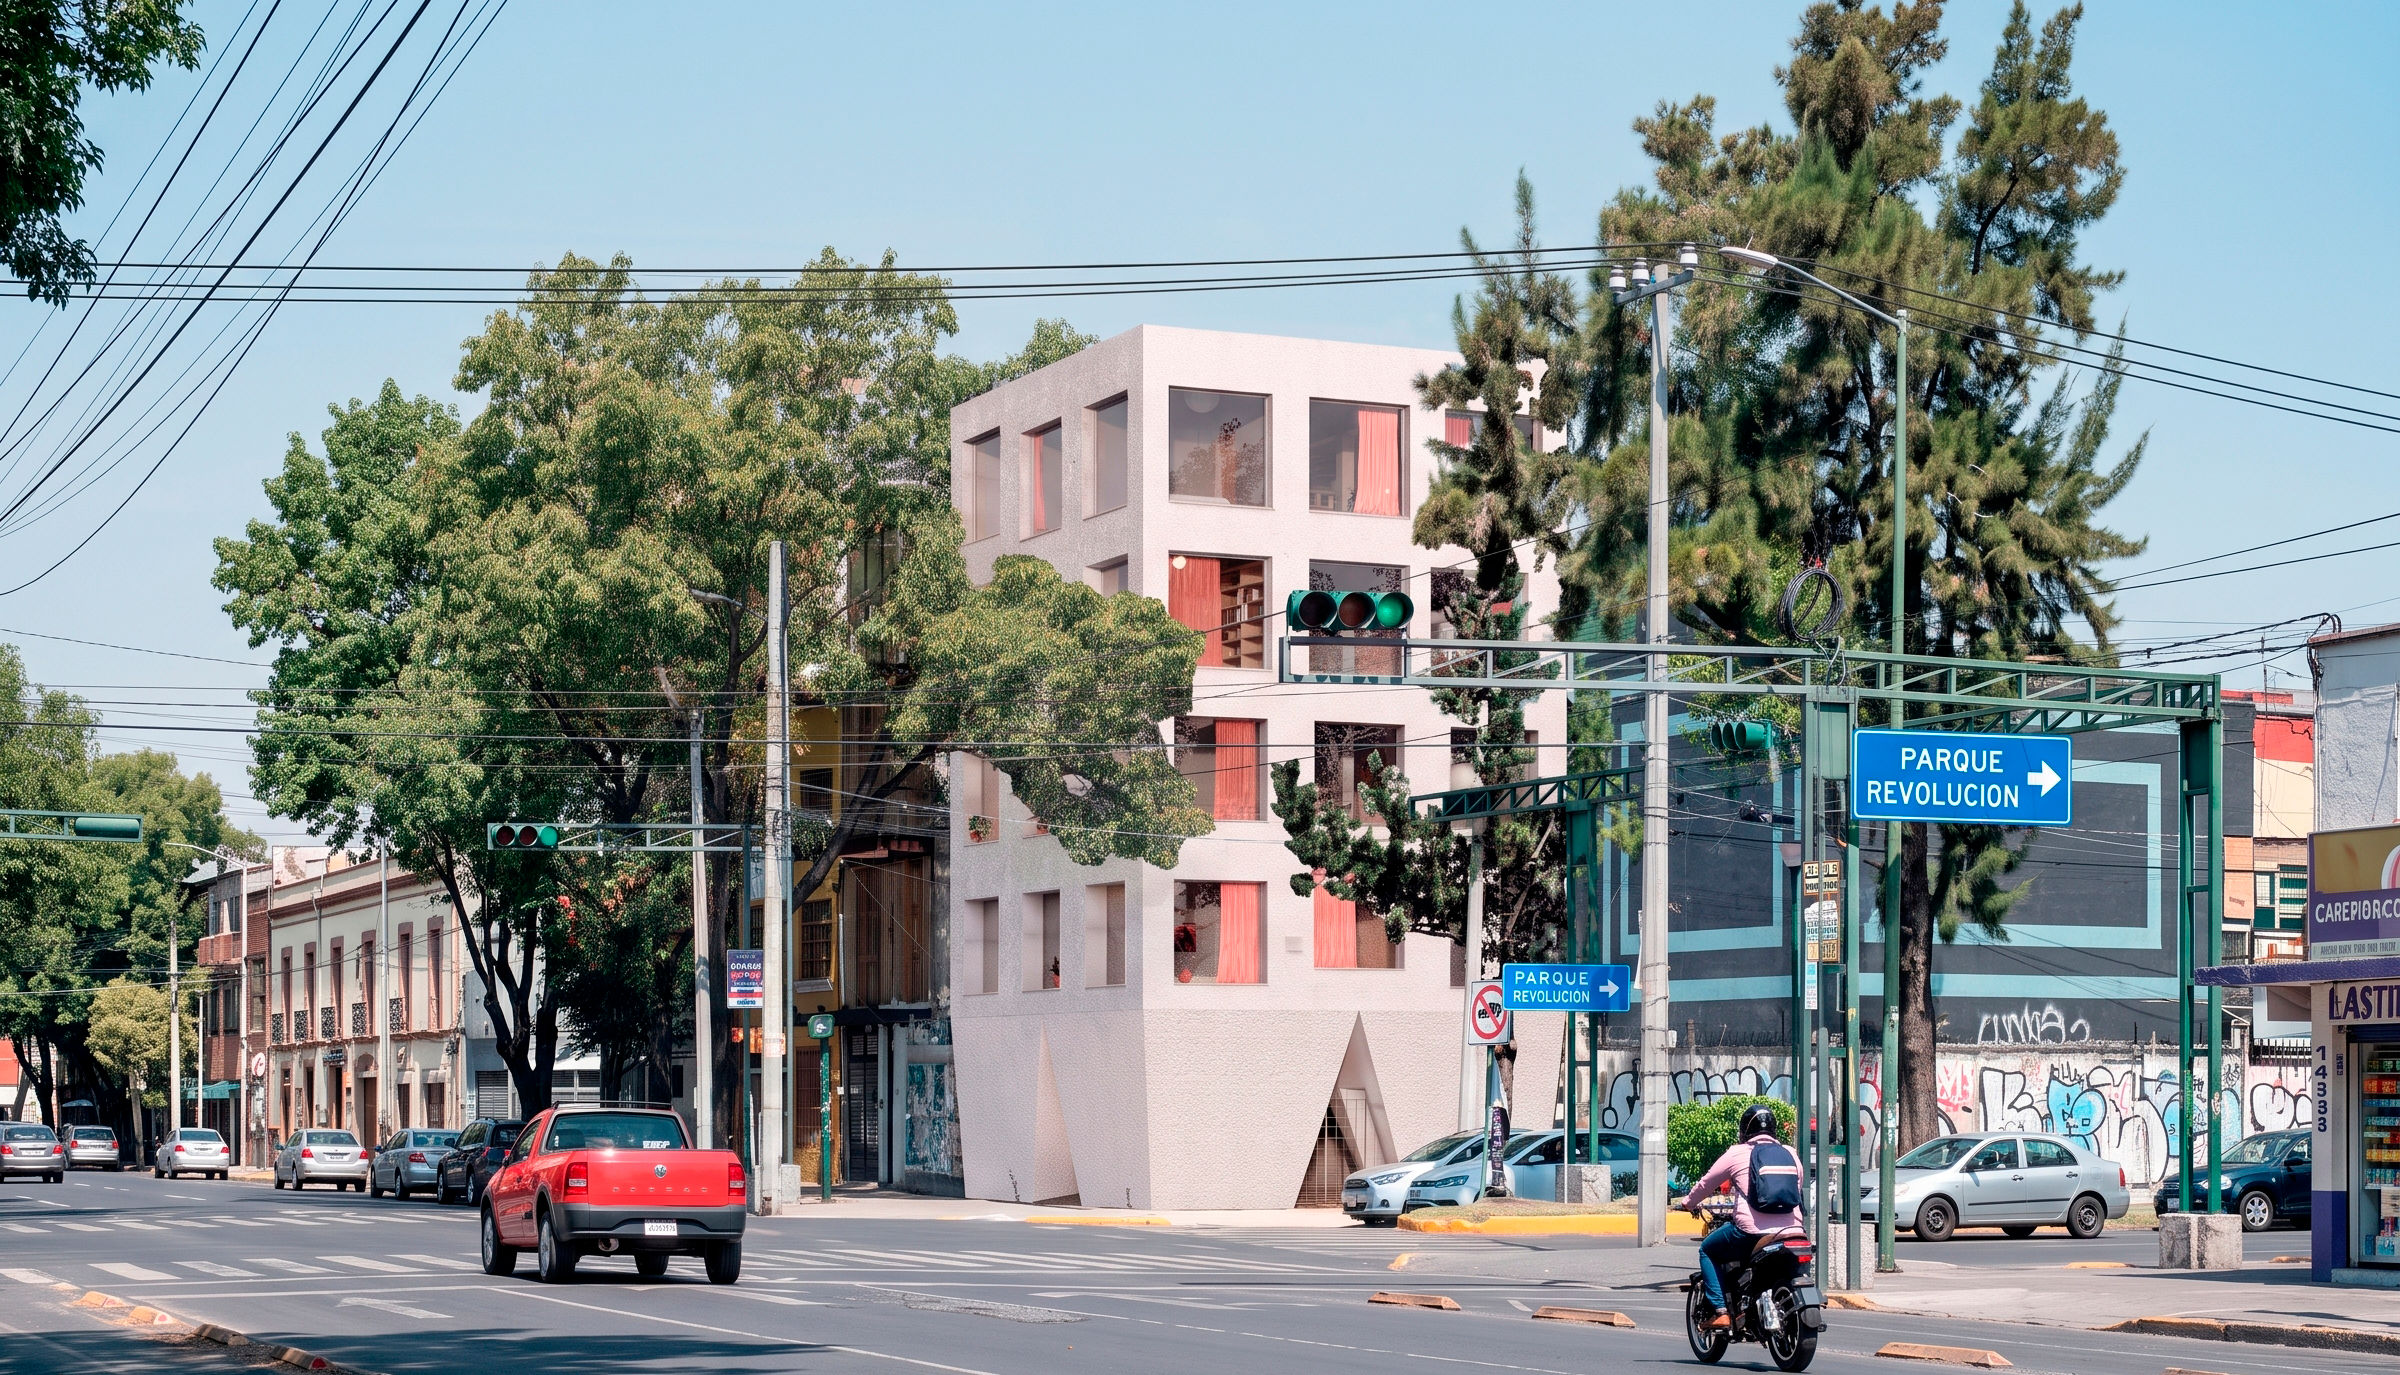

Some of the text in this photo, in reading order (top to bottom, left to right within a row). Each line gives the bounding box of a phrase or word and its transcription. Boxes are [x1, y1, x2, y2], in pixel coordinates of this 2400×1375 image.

[1901, 747, 2004, 773] PARQUE
[1867, 780, 2019, 808] REVOLUCION
[1514, 971, 1589, 986] PARQUE
[1513, 989, 1590, 1003] REVOLUCIÓN
